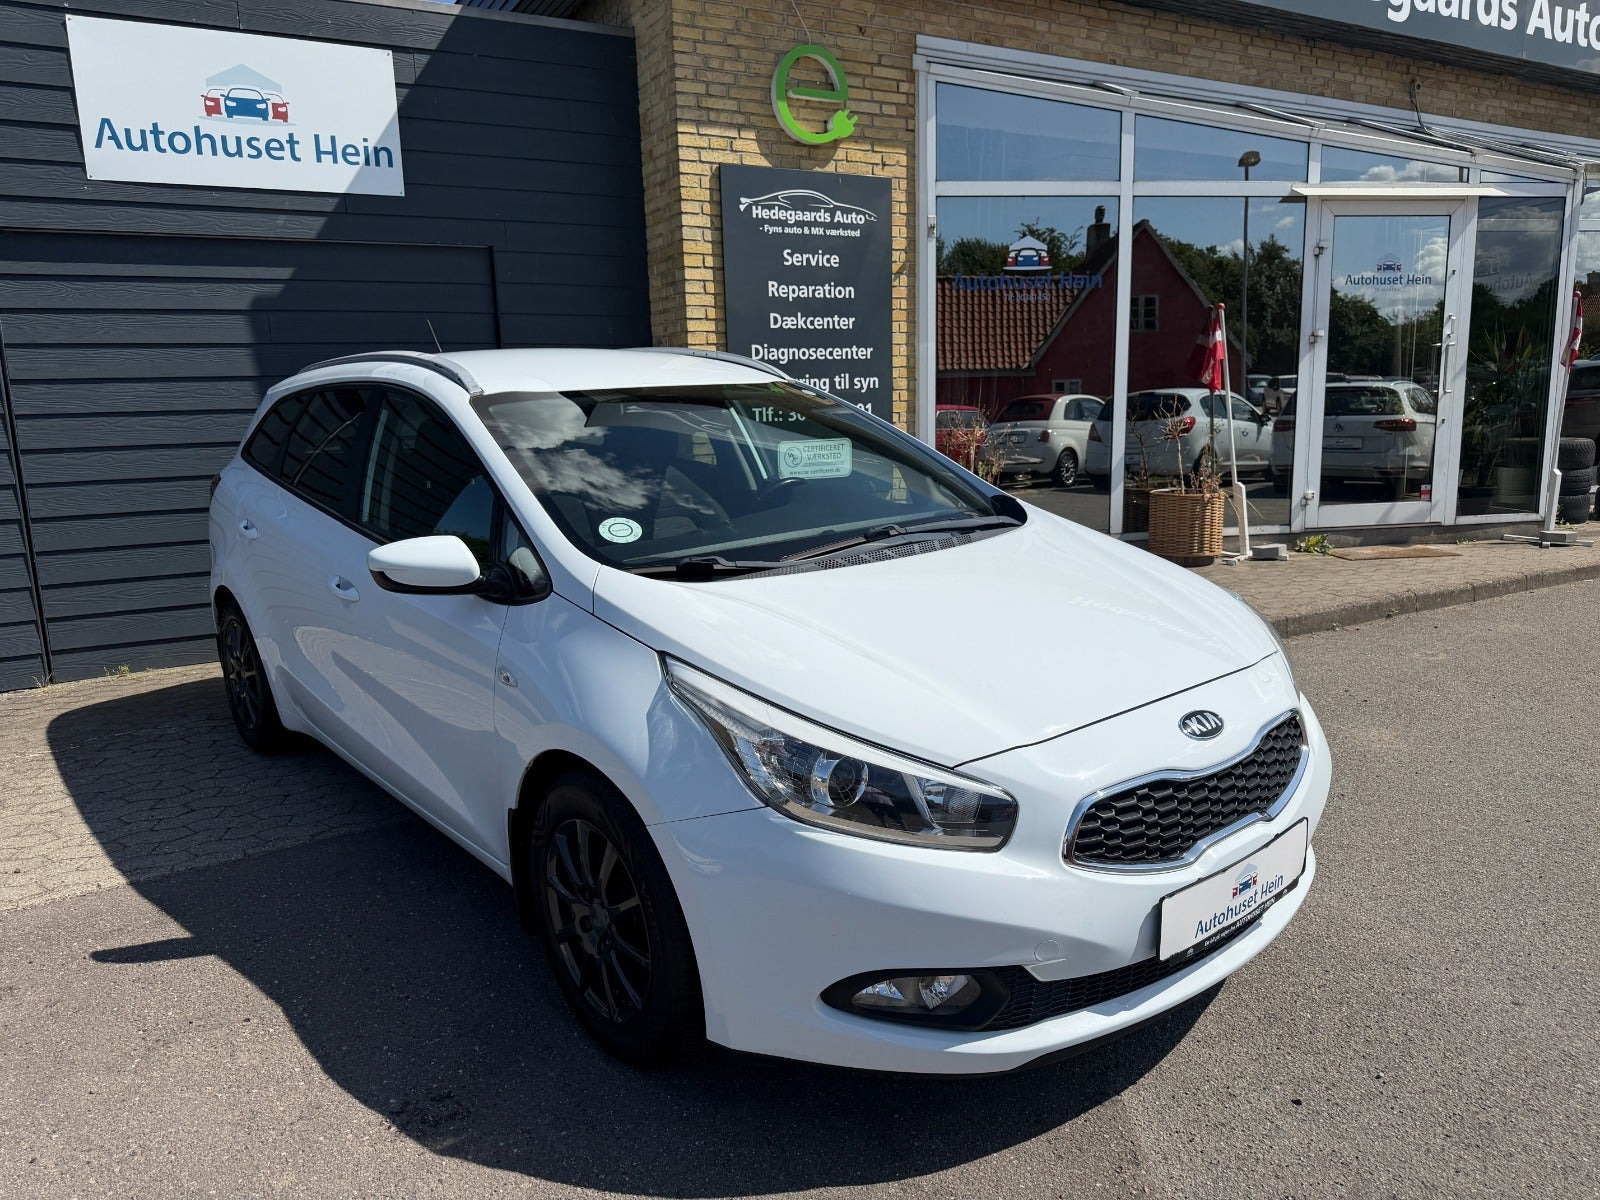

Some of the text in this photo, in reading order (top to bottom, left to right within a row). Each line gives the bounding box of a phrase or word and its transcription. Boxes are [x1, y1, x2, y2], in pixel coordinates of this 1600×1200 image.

[95, 117, 394, 168] Autohuset Hein
[752, 205, 866, 225] Hedegaards Auto
[764, 224, 783, 235] Fyns
[783, 226, 803, 235] auto
[803, 227, 810, 236] &
[811, 226, 825, 236] MX
[825, 228, 861, 238] værksted
[783, 249, 840, 268] Service
[953, 271, 1103, 292] Autohuset Hein
[1345, 274, 1432, 286] Autohuset Hein
[768, 281, 855, 302] Reparation
[769, 312, 856, 330] Dækcenter
[751, 344, 874, 365] Diagnosecenter
[834, 373, 850, 390] til
[853, 377, 879, 393] syn
[803, 443, 845, 453] CERTIFICERET
[806, 452, 841, 460] VÆRKSTED
[1184, 712, 1222, 735] KIA
[1195, 891, 1259, 938] Autohuset
[1260, 874, 1284, 900] Hein
